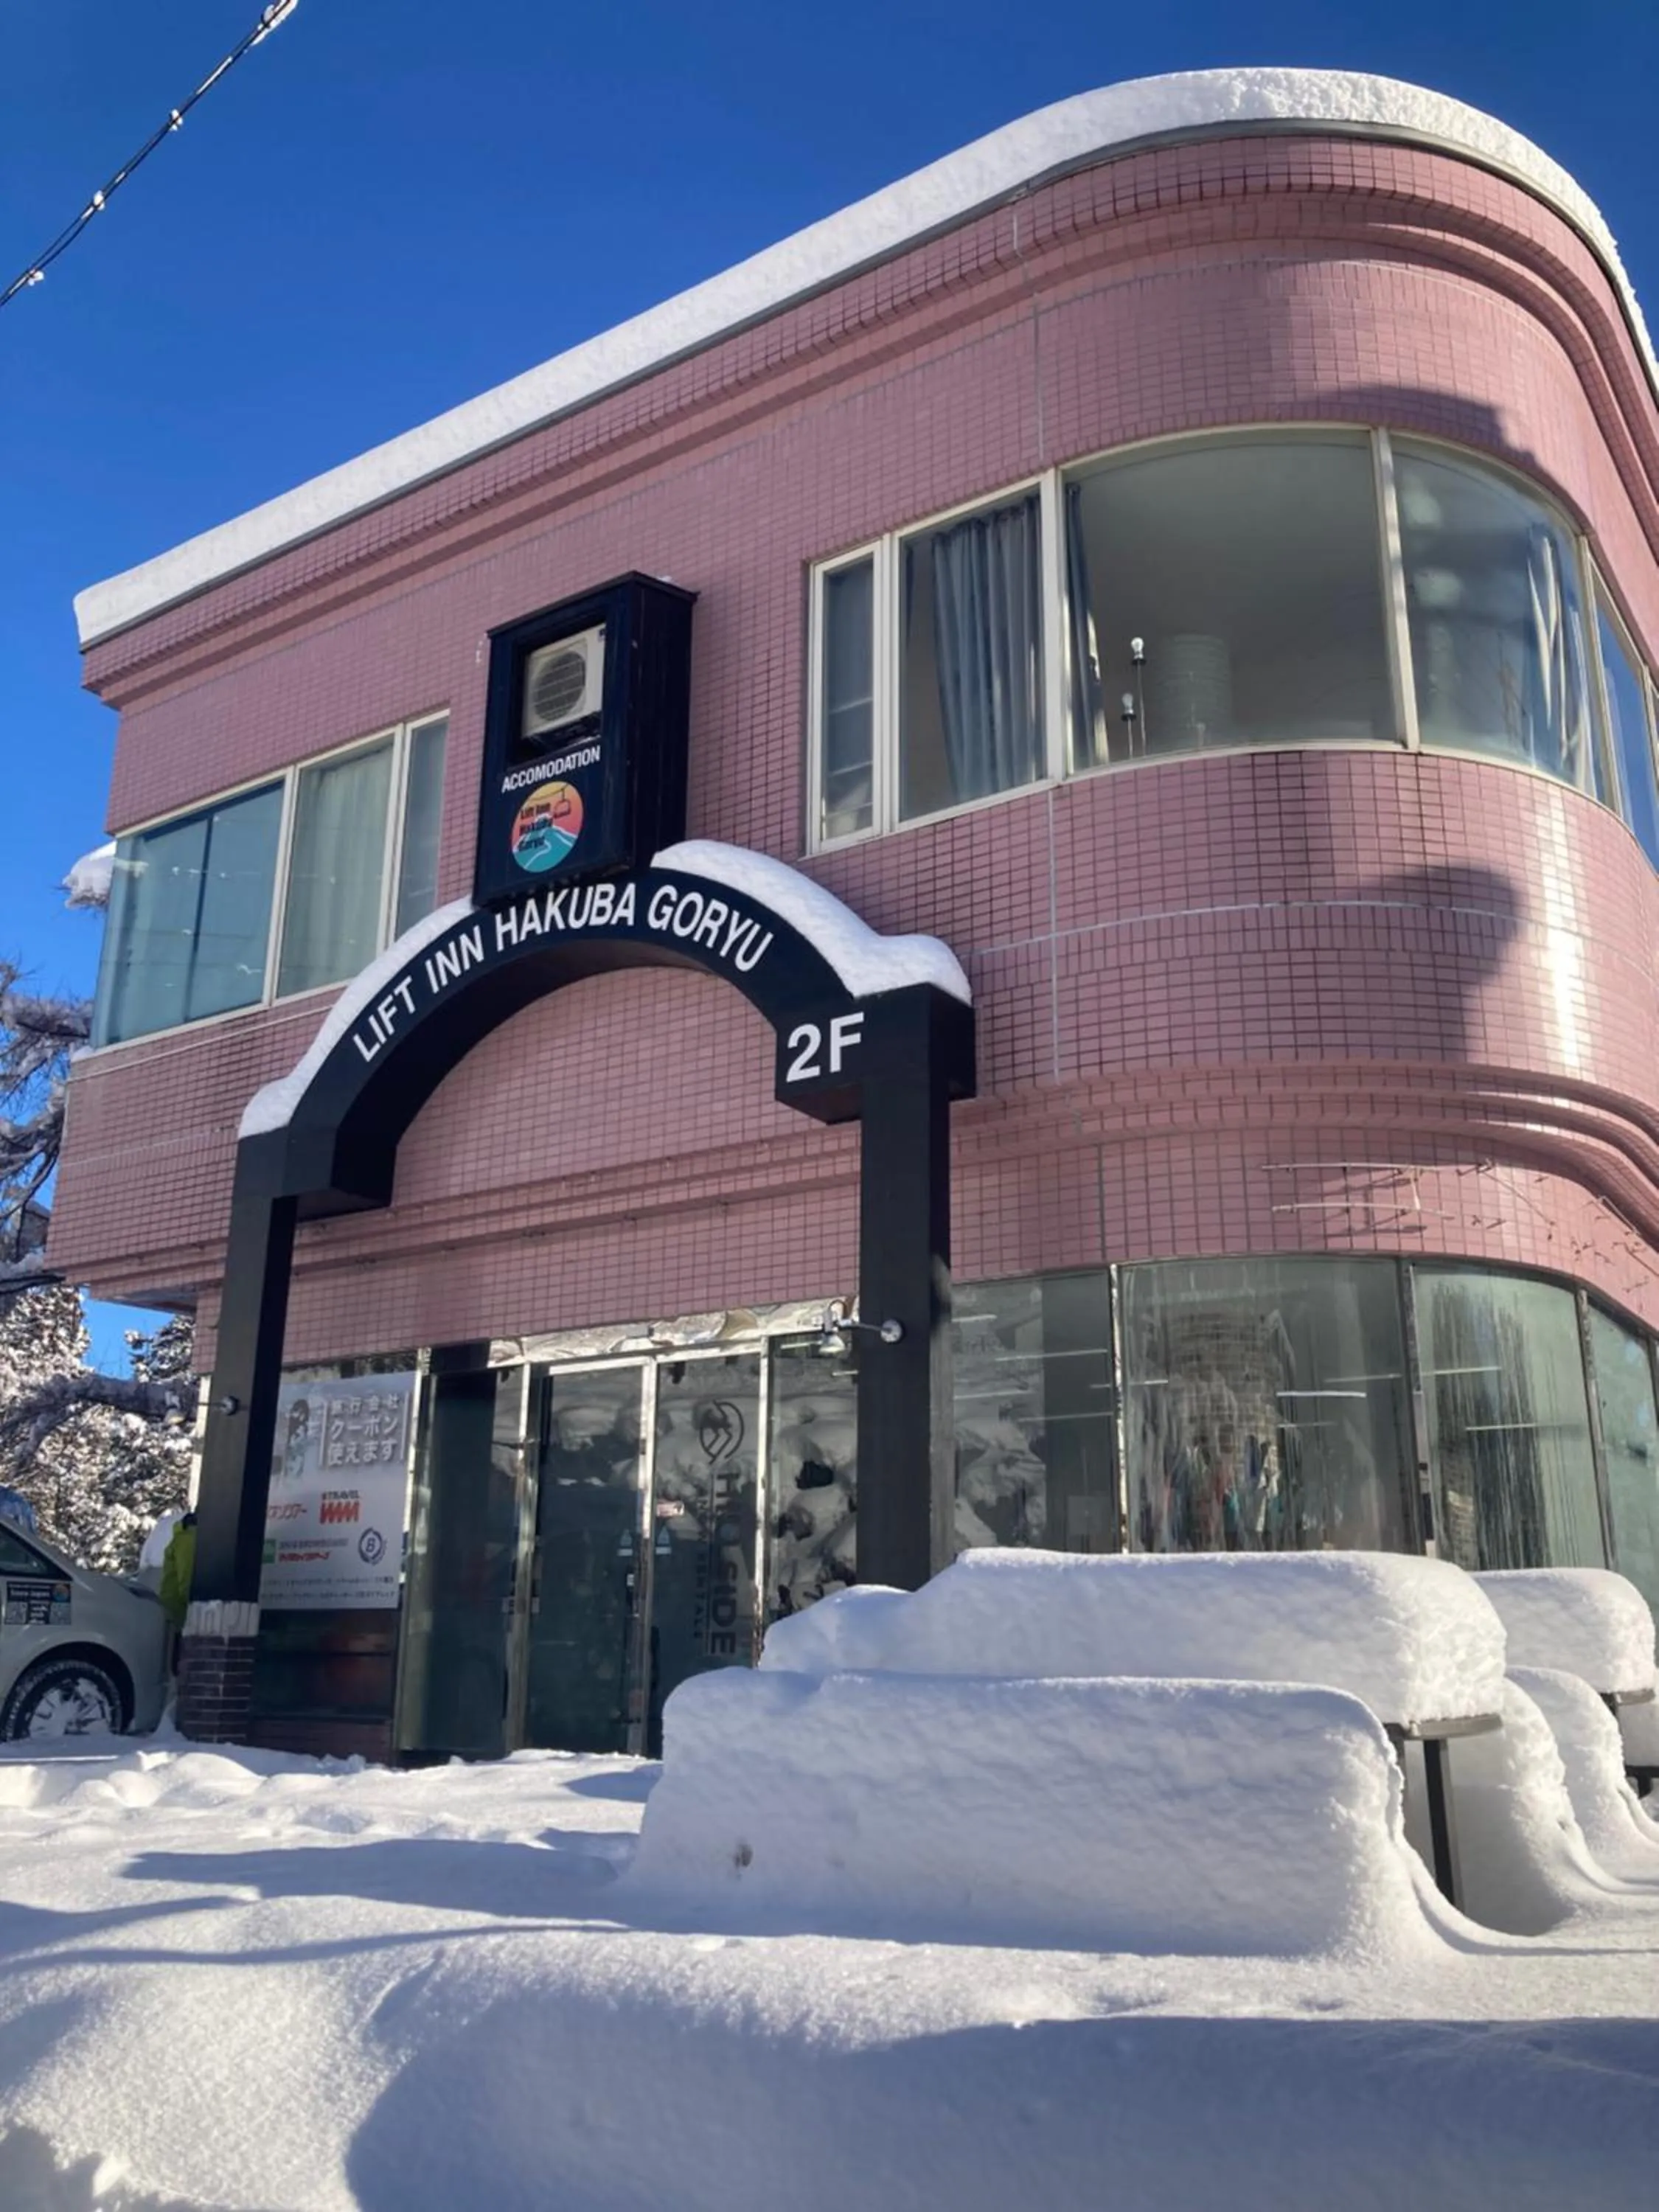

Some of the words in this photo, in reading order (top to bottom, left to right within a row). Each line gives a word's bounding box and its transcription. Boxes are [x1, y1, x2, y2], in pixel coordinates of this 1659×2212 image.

[501, 745, 601, 793] ACCOMODATION
[352, 976, 420, 1062] LIFT
[425, 927, 484, 993] INN
[494, 883, 636, 952] HAKUBA
[647, 885, 774, 973] GORYU
[786, 1012, 865, 1083] 2F
[330, 1415, 399, 1440] クーポン
[328, 1439, 398, 1466] 使えます
